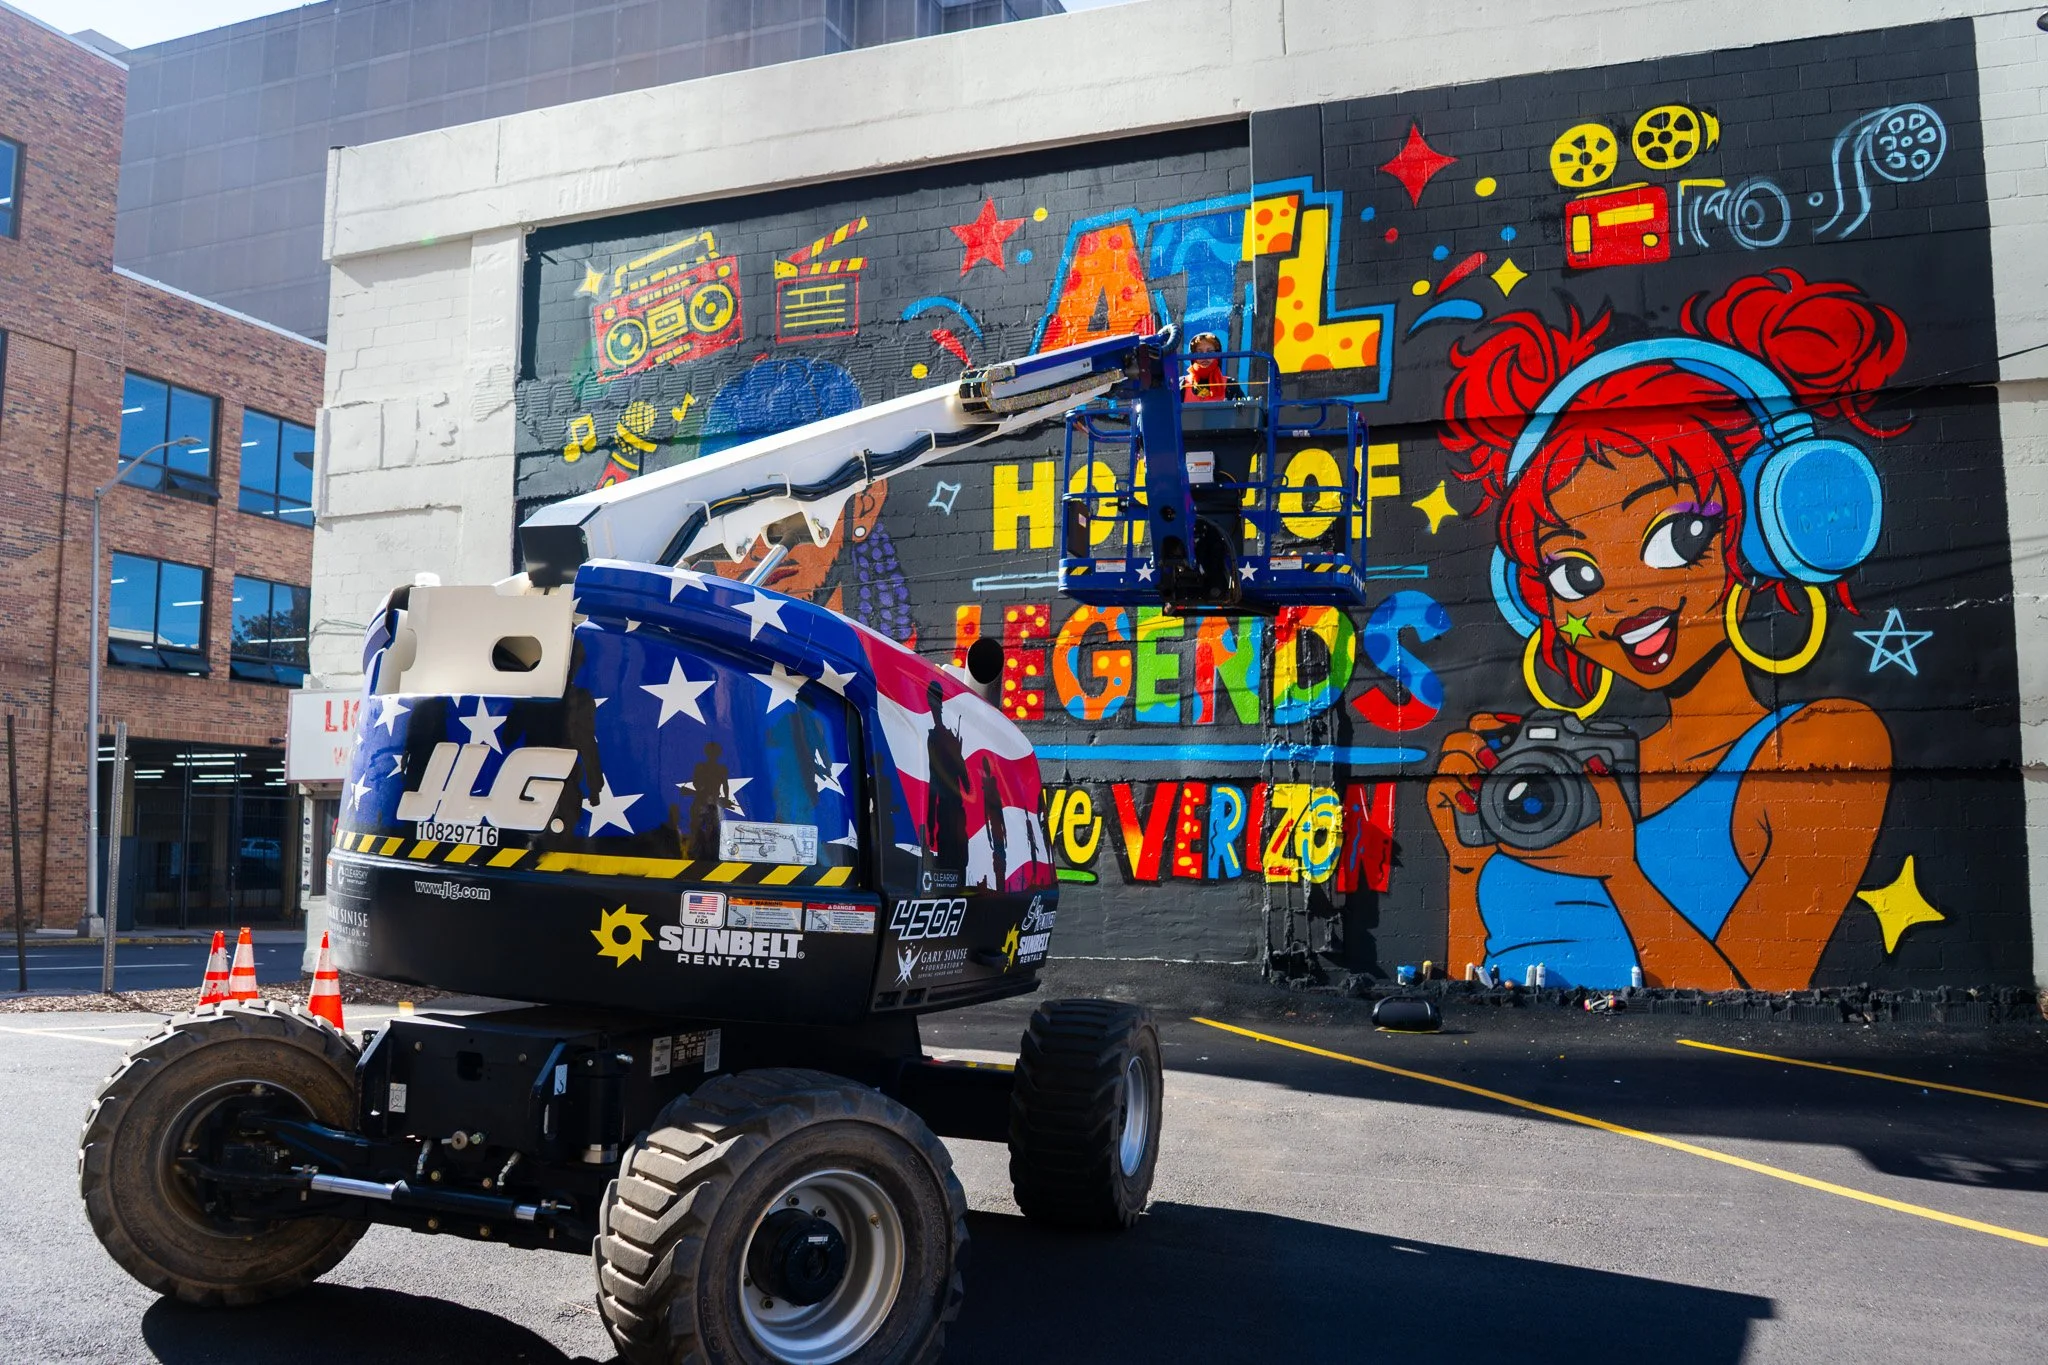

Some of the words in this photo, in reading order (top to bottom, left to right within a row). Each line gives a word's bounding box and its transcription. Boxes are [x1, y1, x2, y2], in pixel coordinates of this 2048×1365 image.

[1035, 192, 1382, 375] ATL
[993, 451, 1258, 550] HO
[417, 820, 499, 847] 10829716
[1110, 781, 1397, 893] VERIZON
[933, 872, 959, 883] CLEARSKY
[414, 880, 491, 901] www.jlg.com
[340, 908, 369, 928] SINISE
[694, 917, 709, 925] USA
[889, 897, 967, 941] 450A
[1017, 931, 1051, 956] SUNBELT
[677, 953, 780, 969] RENTALS
[920, 950, 943, 963] GARY
[943, 947, 968, 962] SINISE
[1019, 952, 1043, 964] RENTALS
